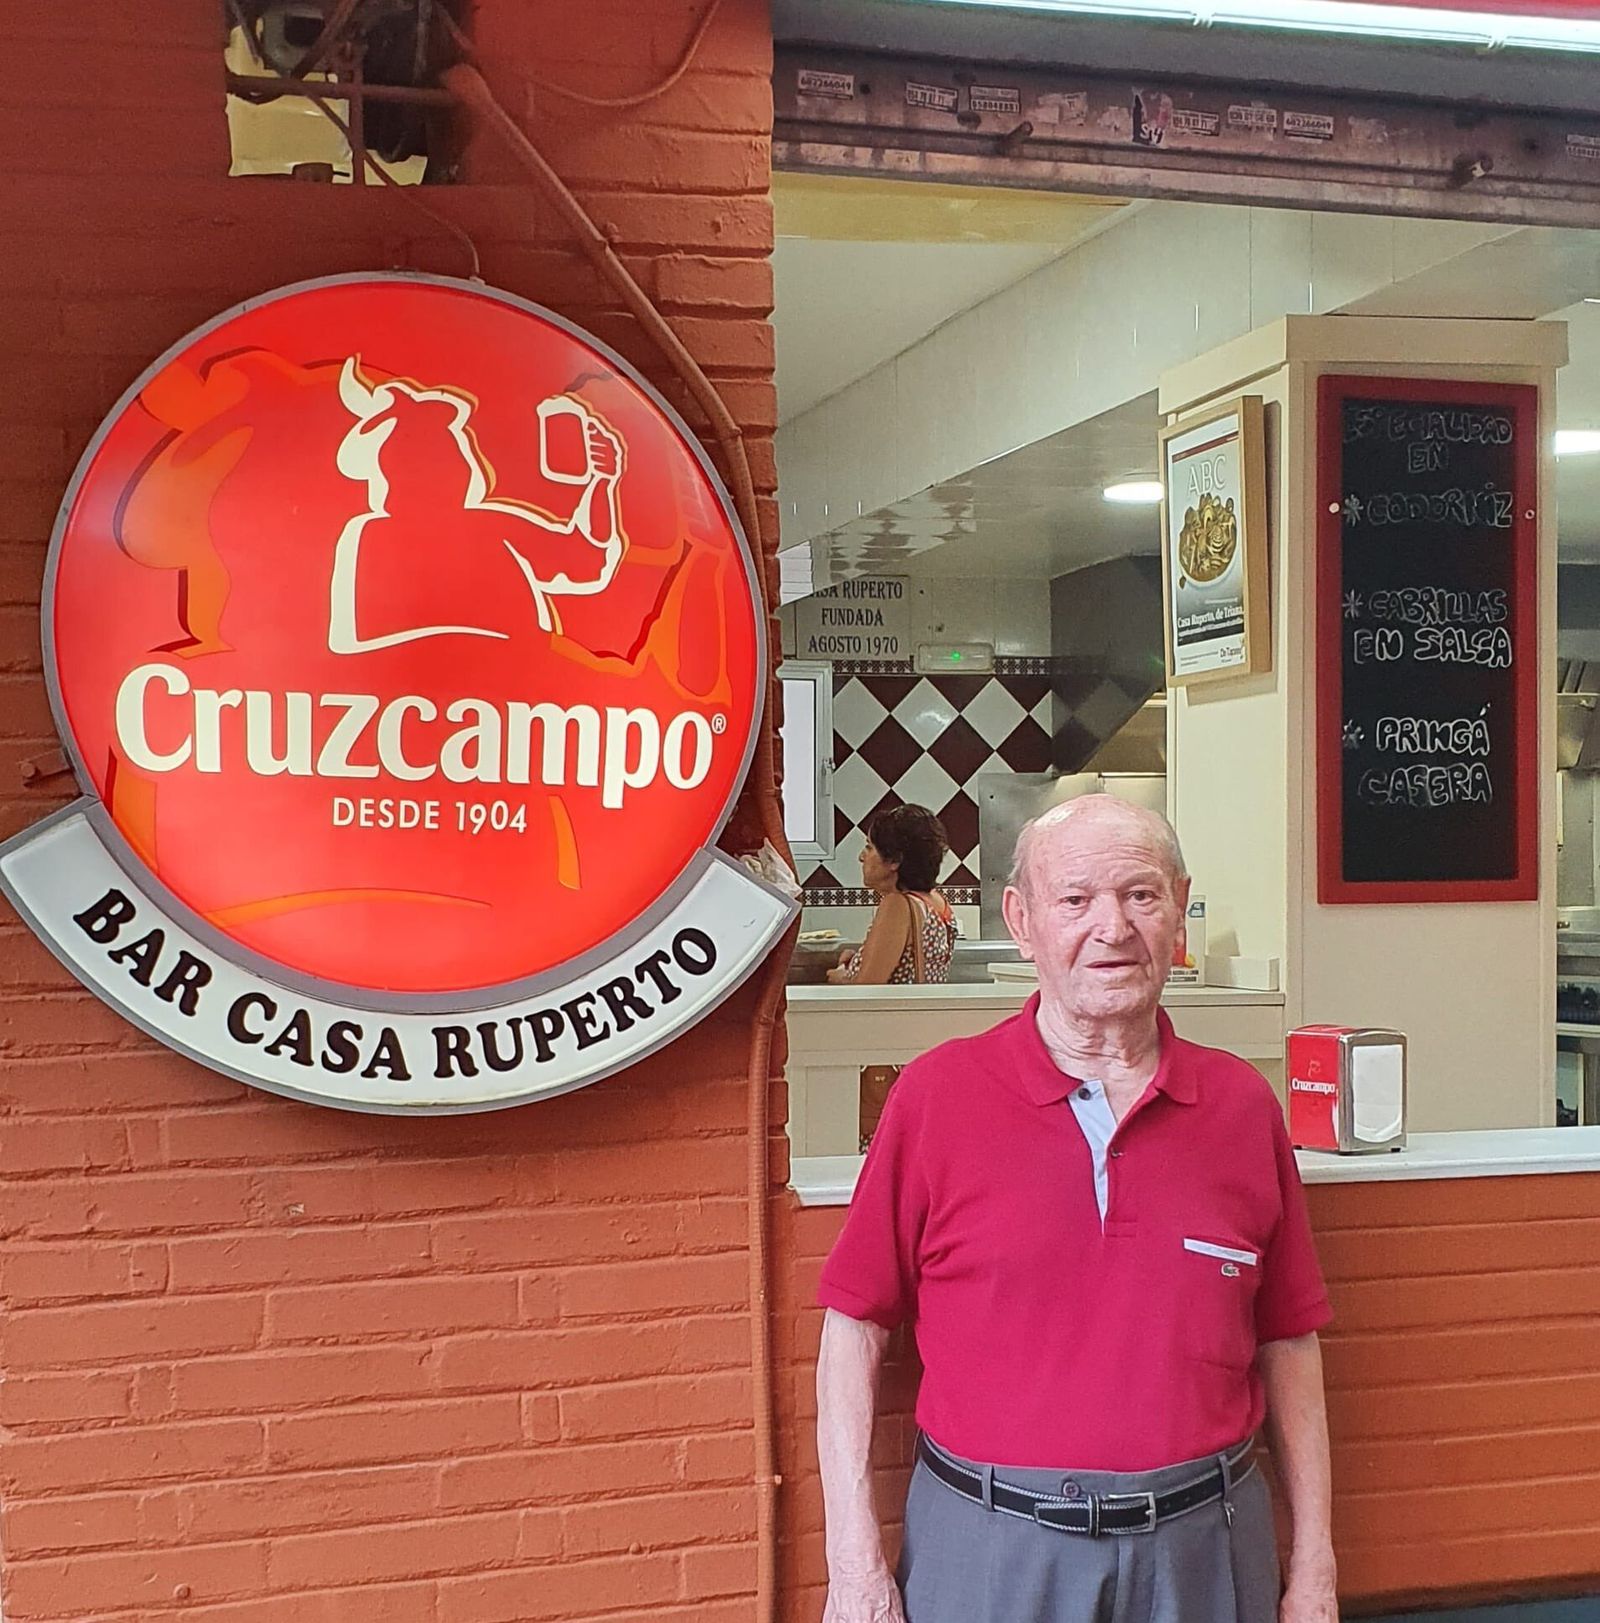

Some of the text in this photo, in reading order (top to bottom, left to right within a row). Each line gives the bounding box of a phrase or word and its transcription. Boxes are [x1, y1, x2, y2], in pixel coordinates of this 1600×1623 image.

[1188, 455, 1226, 496] ABC
[843, 580, 903, 600] RUPERTO
[1368, 586, 1508, 626] CABRILLAS
[821, 608, 884, 627] FUNDADA
[1177, 616, 1191, 628] Casa
[1215, 608, 1224, 620] de
[808, 635, 899, 654] AGOSTO 1970
[1354, 626, 1513, 669] EN SALSA
[1376, 702, 1491, 756] PRINGÁ
[1358, 762, 1493, 807] CASERA
[332, 797, 528, 834] DESDE 1904
[73, 888, 718, 1082] BAR CASA RUPERTO
